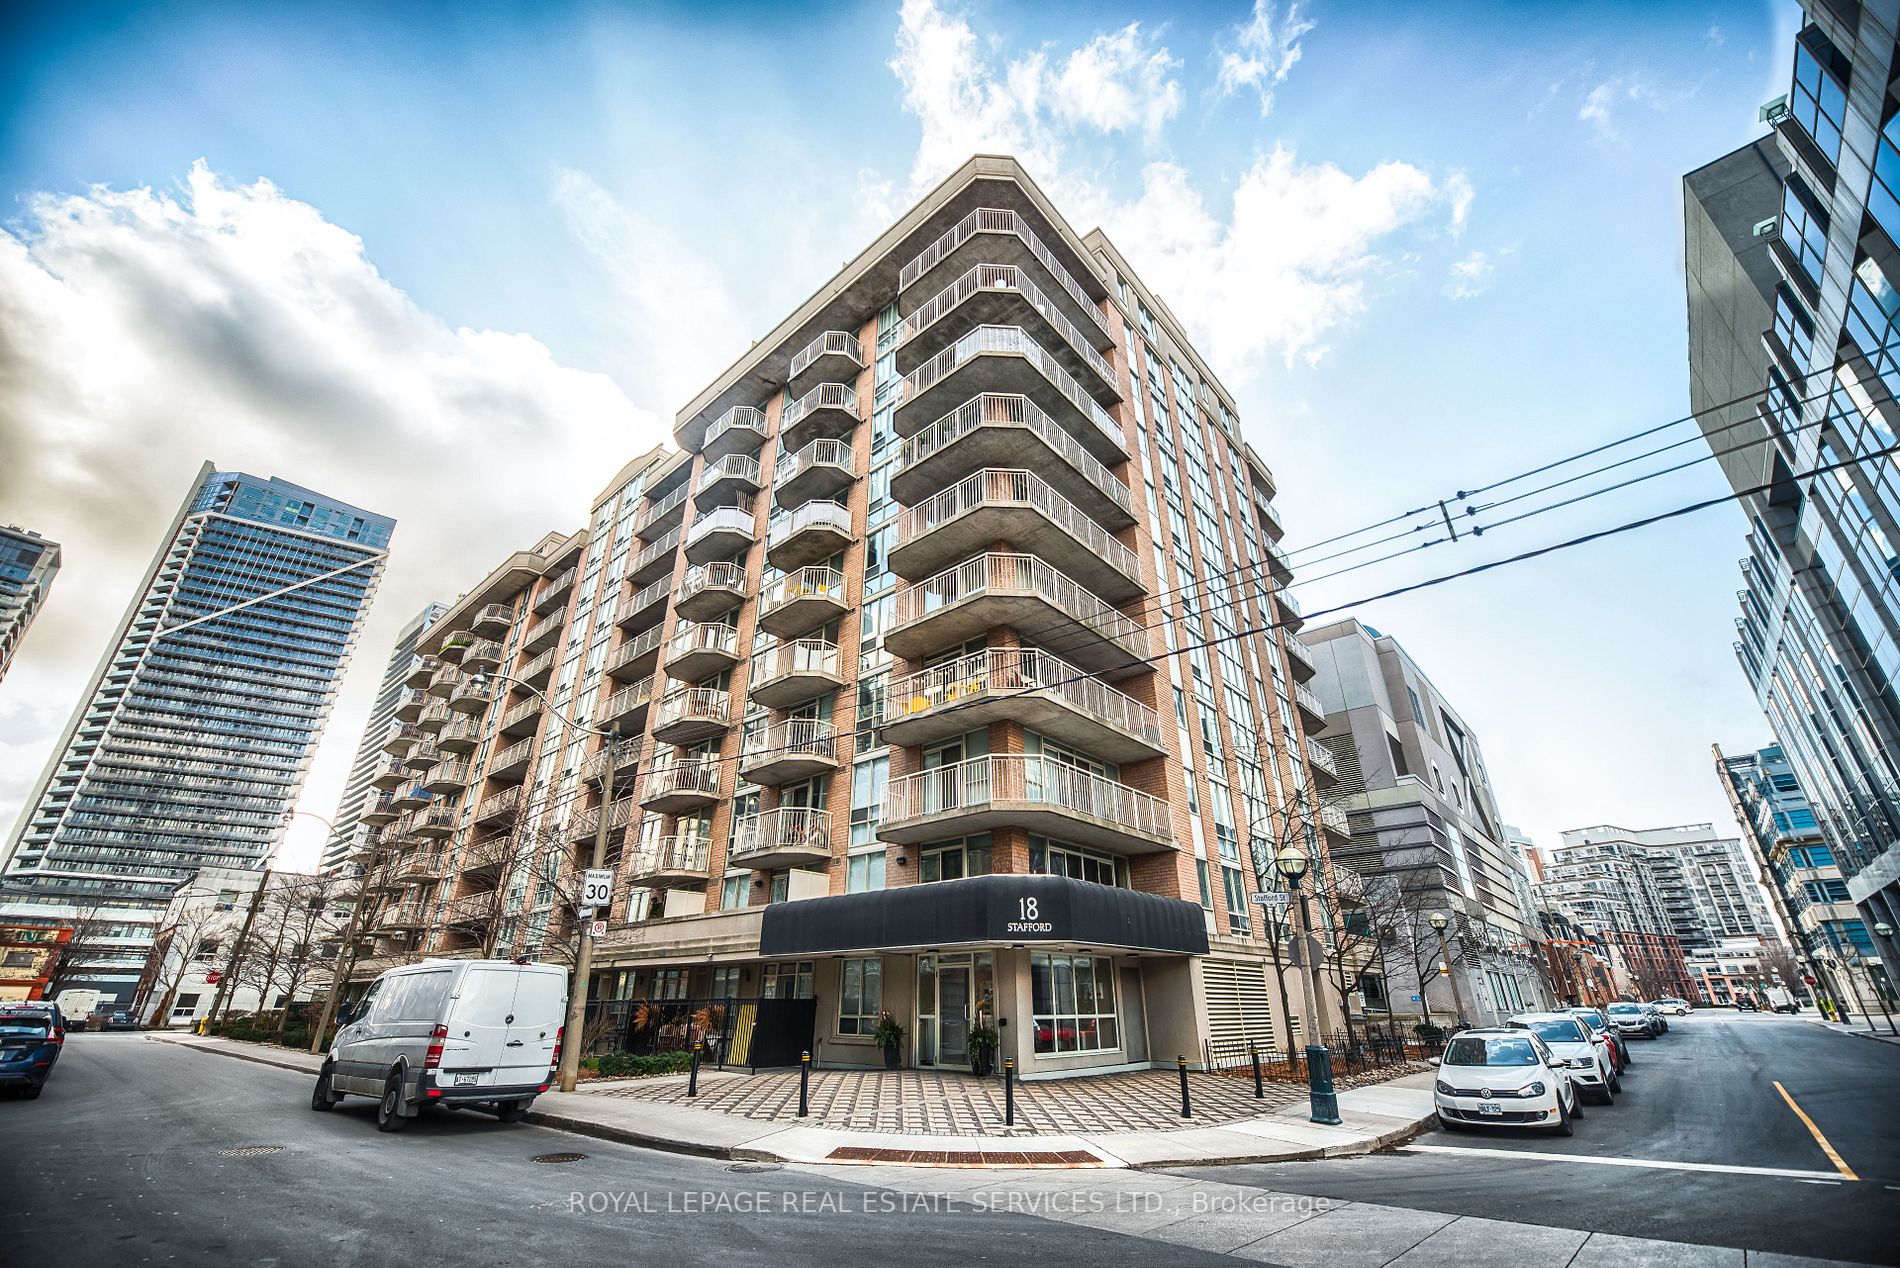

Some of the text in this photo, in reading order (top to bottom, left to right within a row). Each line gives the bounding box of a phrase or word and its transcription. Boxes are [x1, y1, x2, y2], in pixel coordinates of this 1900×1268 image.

[585, 884, 608, 900] 30
[1254, 894, 1278, 902] Stafford
[1019, 896, 1039, 920] 18
[1007, 922, 1052, 932] STAFFORD
